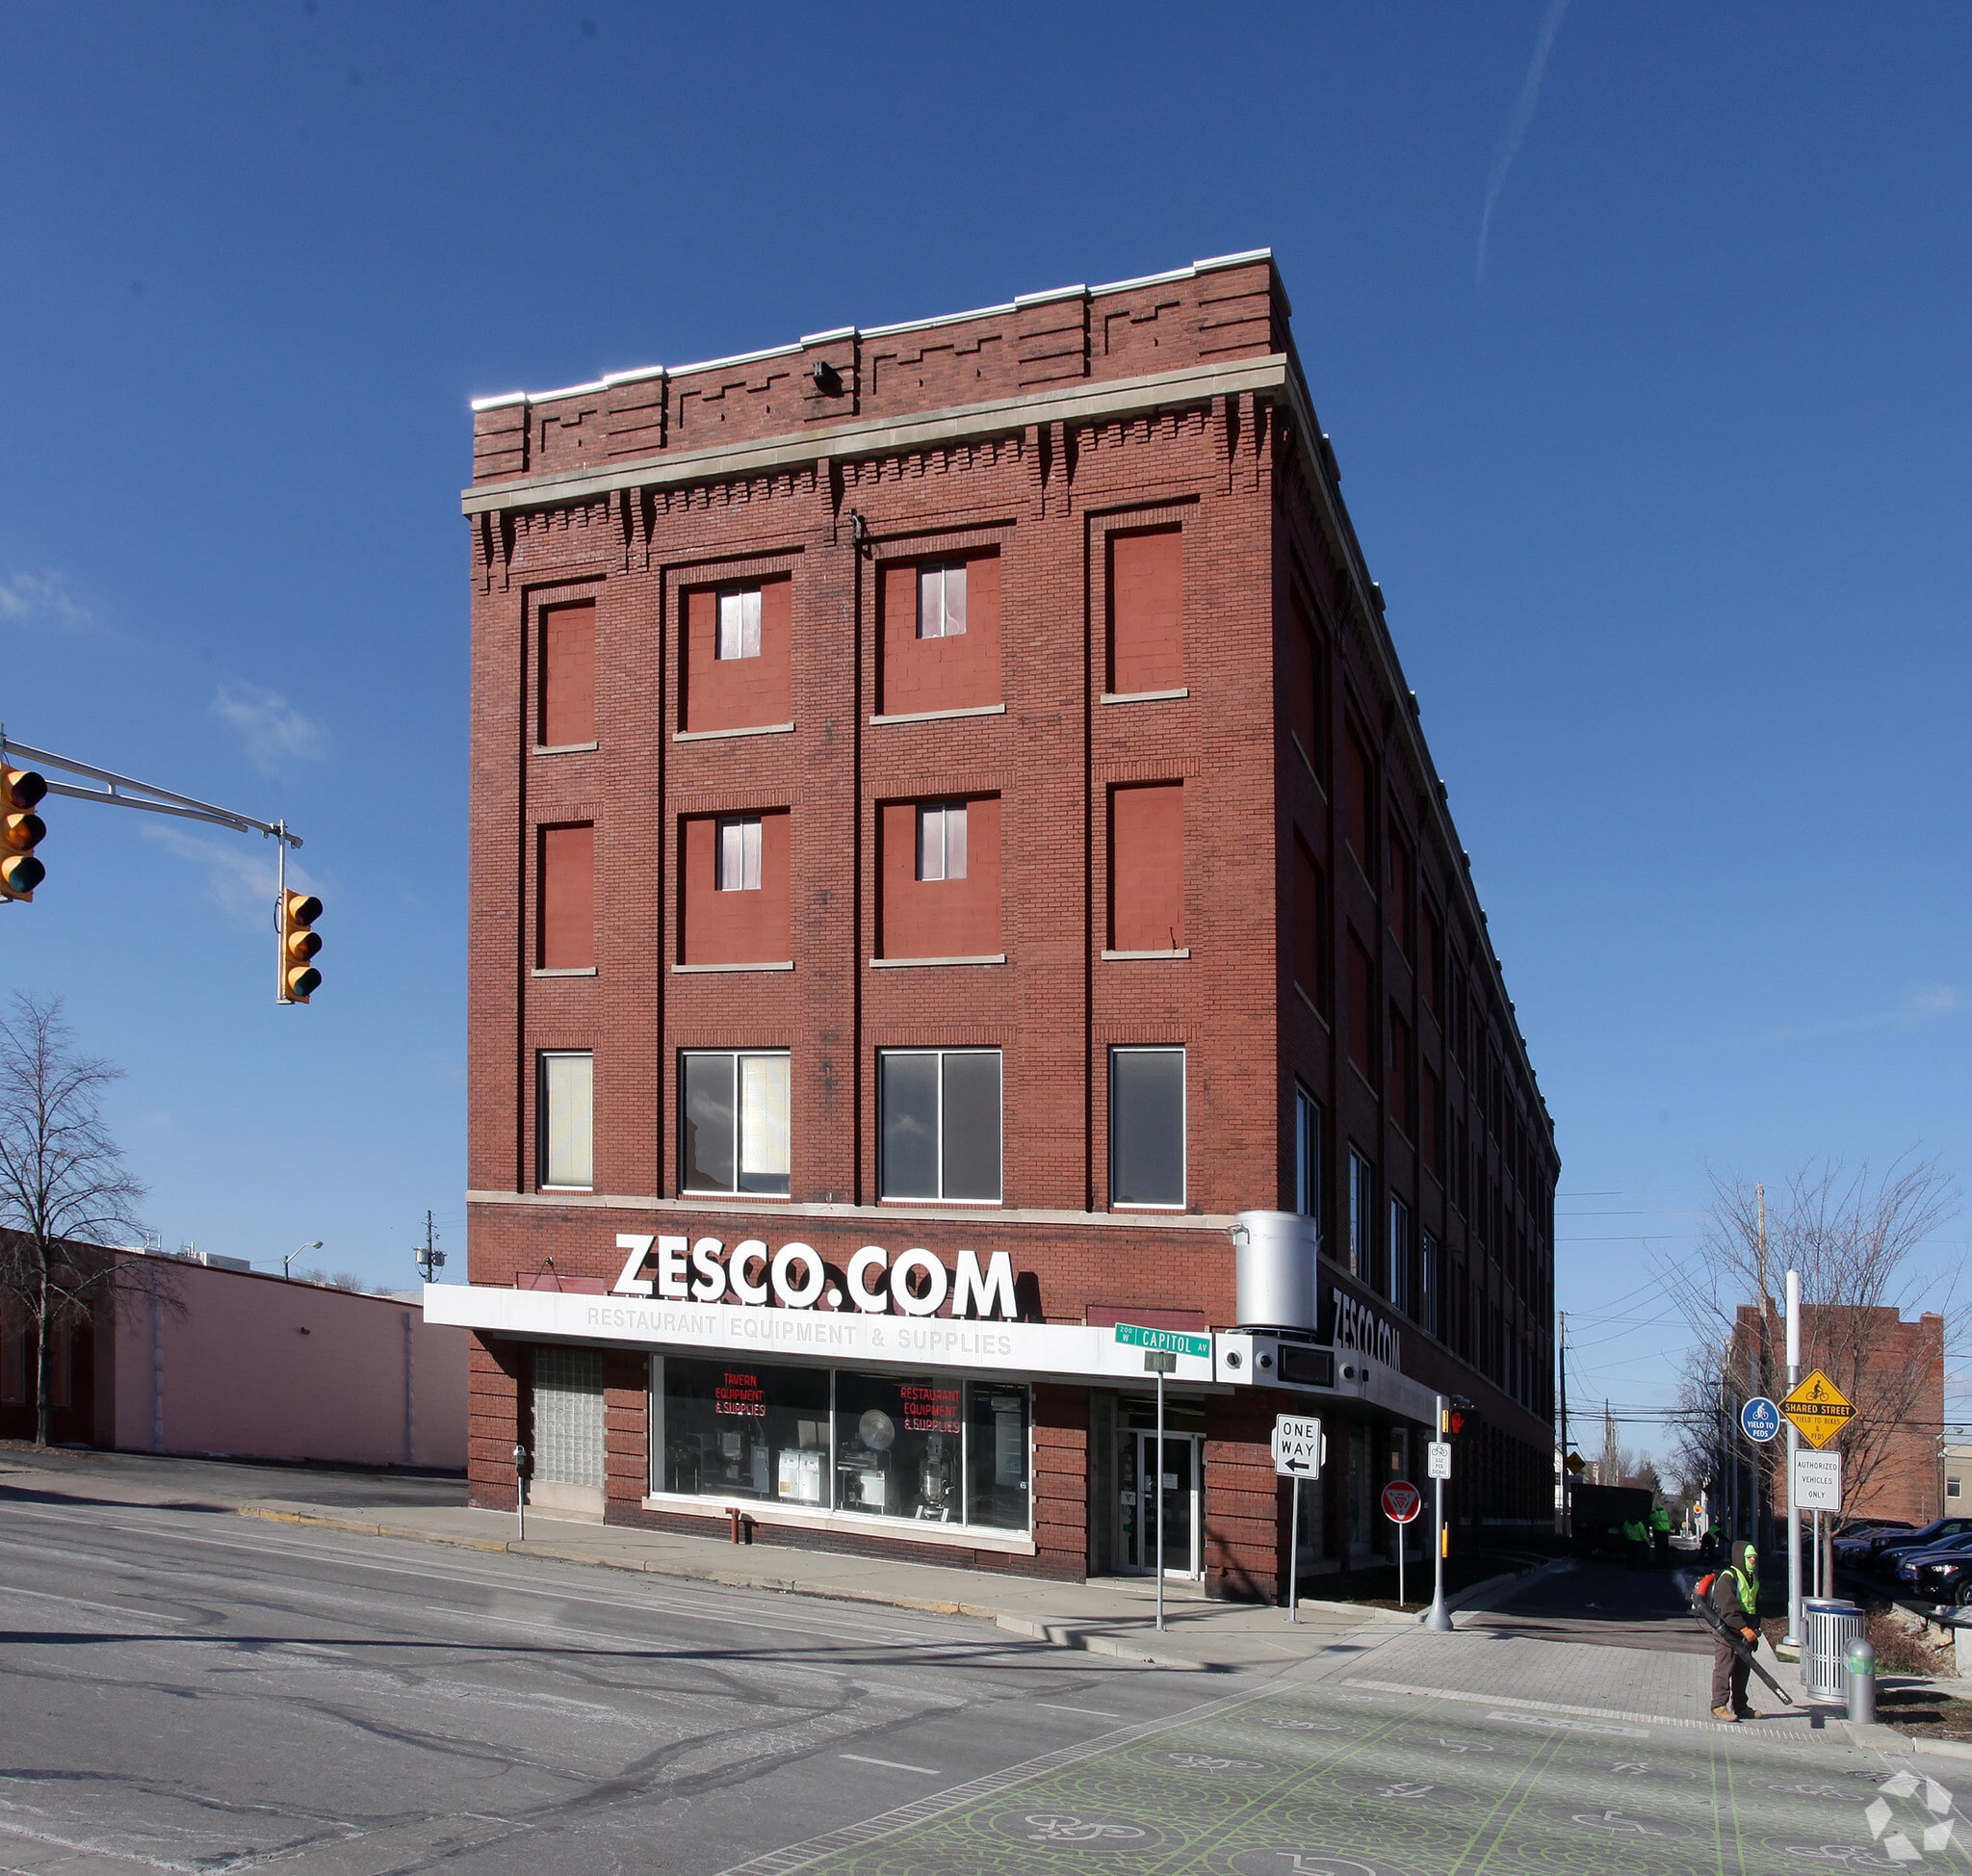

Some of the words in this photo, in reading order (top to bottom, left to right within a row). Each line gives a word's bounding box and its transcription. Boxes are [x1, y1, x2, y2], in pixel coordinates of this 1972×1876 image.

[612, 1234, 1018, 1318] ZESCO.COM
[587, 1307, 716, 1334] RESTAURANT
[730, 1317, 857, 1345] EQUIPMENT
[871, 1328, 885, 1347] &
[897, 1329, 1012, 1356] SUPPLIES
[1122, 1334, 1129, 1342] W
[1142, 1331, 1192, 1353] CAPITOL
[1197, 1343, 1207, 1352] AV
[724, 1372, 757, 1386] TAVERN
[715, 1387, 765, 1401] EQUIPMENT
[900, 1387, 961, 1402] RESTAURANT
[715, 1401, 723, 1414] &
[723, 1401, 765, 1417] SUPPLIES
[904, 1402, 957, 1418] EQUIPMENT
[1785, 1404, 1818, 1414] SHARED
[1821, 1406, 1850, 1416] STREET
[904, 1418, 912, 1430] &
[913, 1418, 960, 1433] SUPPLIES
[1284, 1422, 1313, 1439] ONE
[1748, 1420, 1764, 1429] YIELD
[1282, 1441, 1314, 1457] WAY
[1797, 1461, 1837, 1471] AUTHORIZED
[1802, 1475, 1832, 1485] VEHICLES
[1808, 1490, 1825, 1498] ONLY
